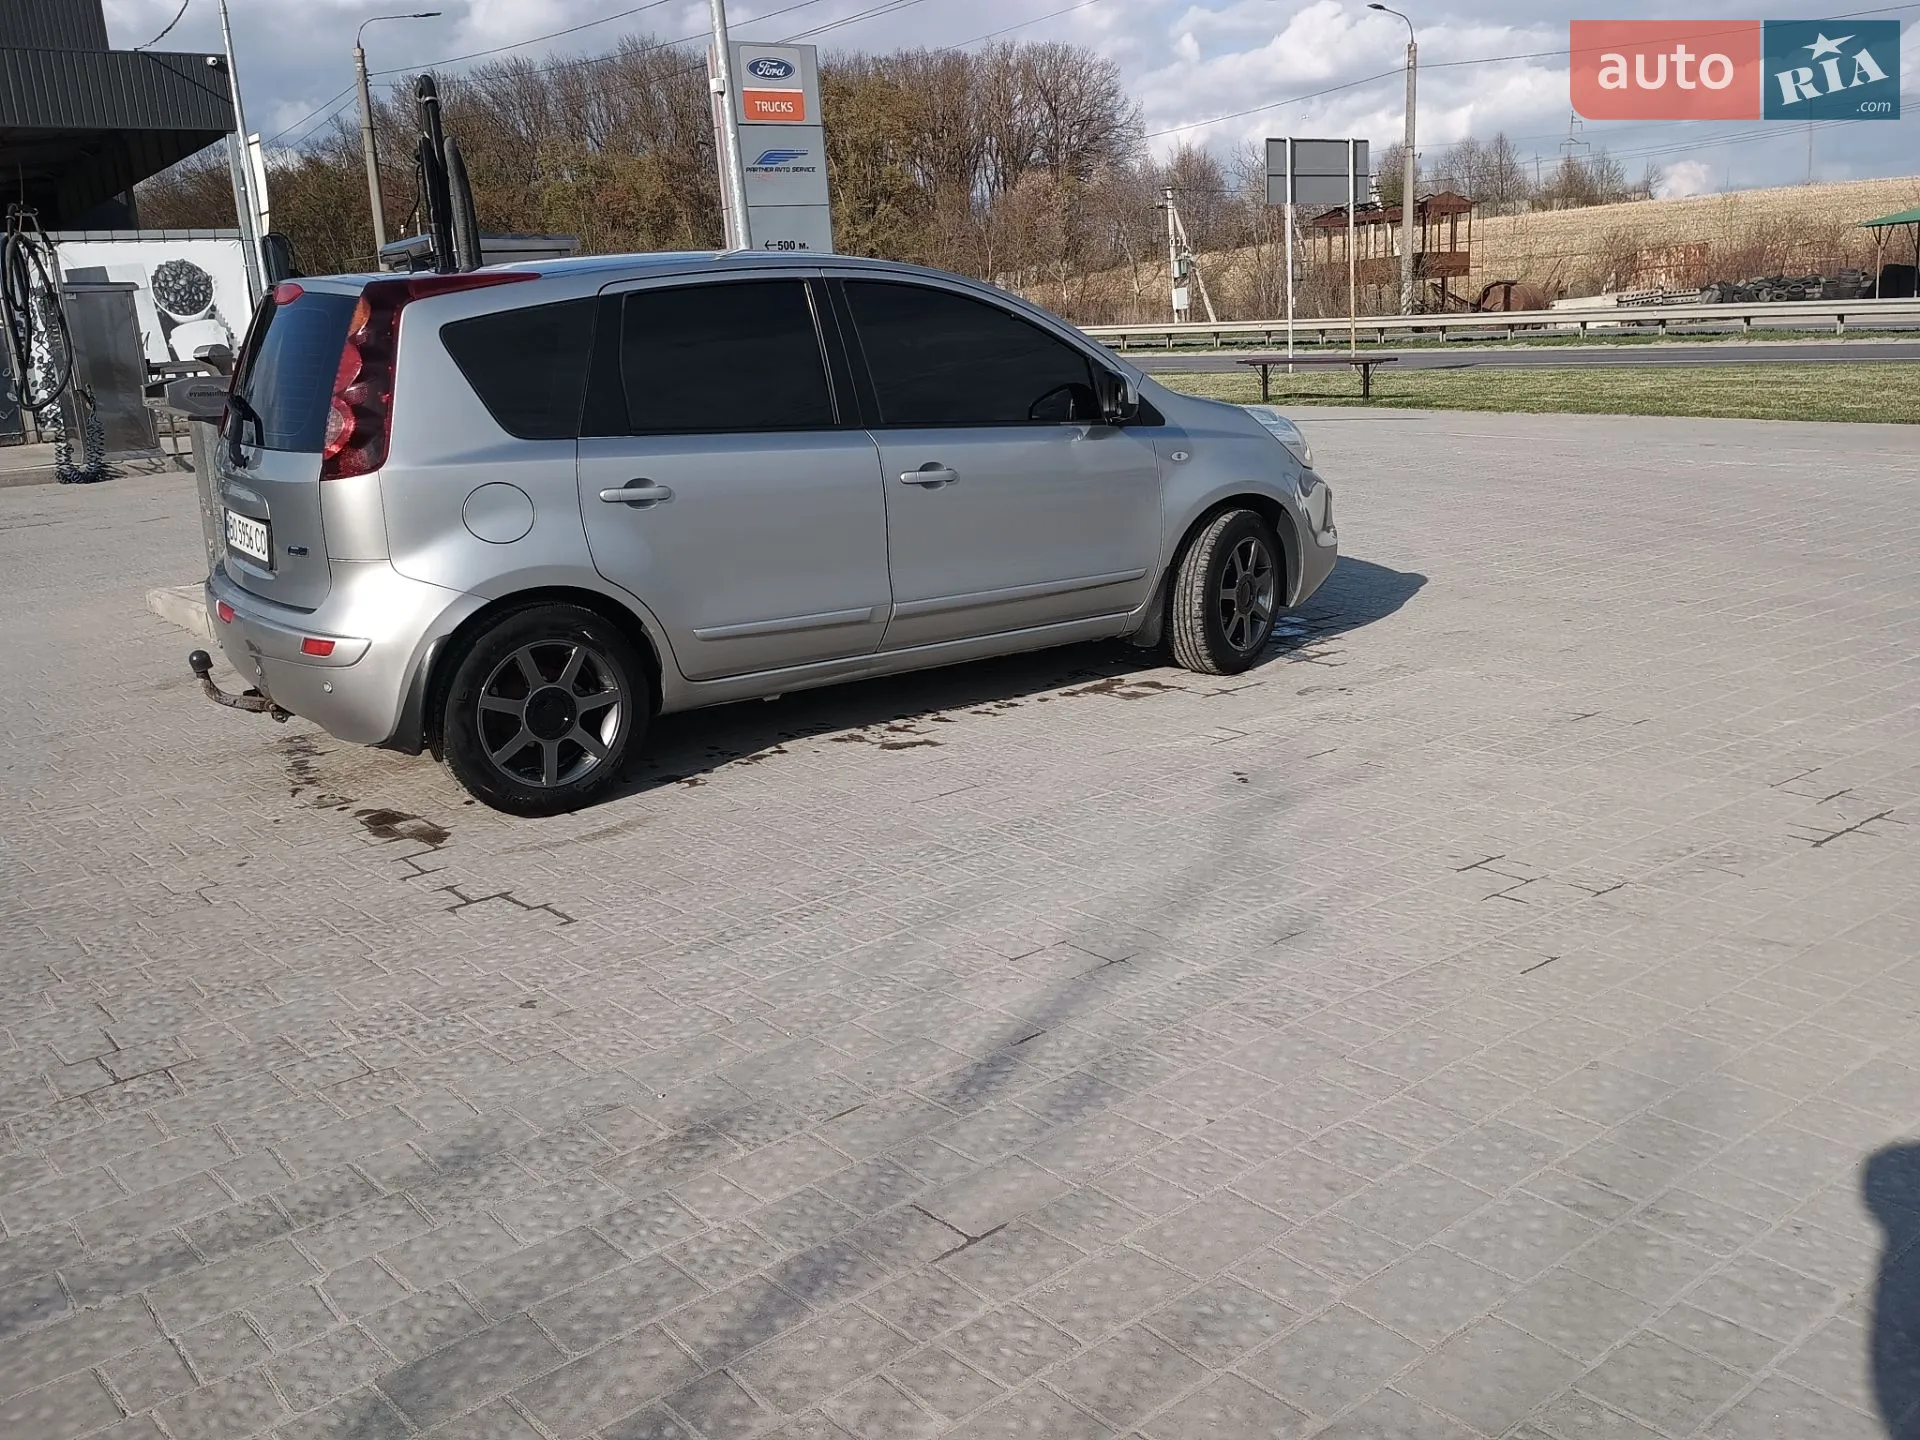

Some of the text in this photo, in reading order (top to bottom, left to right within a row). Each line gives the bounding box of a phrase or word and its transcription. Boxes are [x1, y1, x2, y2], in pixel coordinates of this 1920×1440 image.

[756, 60, 786, 77] Ford
[755, 101, 793, 112] TRUCKS
[778, 241, 795, 250] 500
[239, 520, 253, 549] 5956
